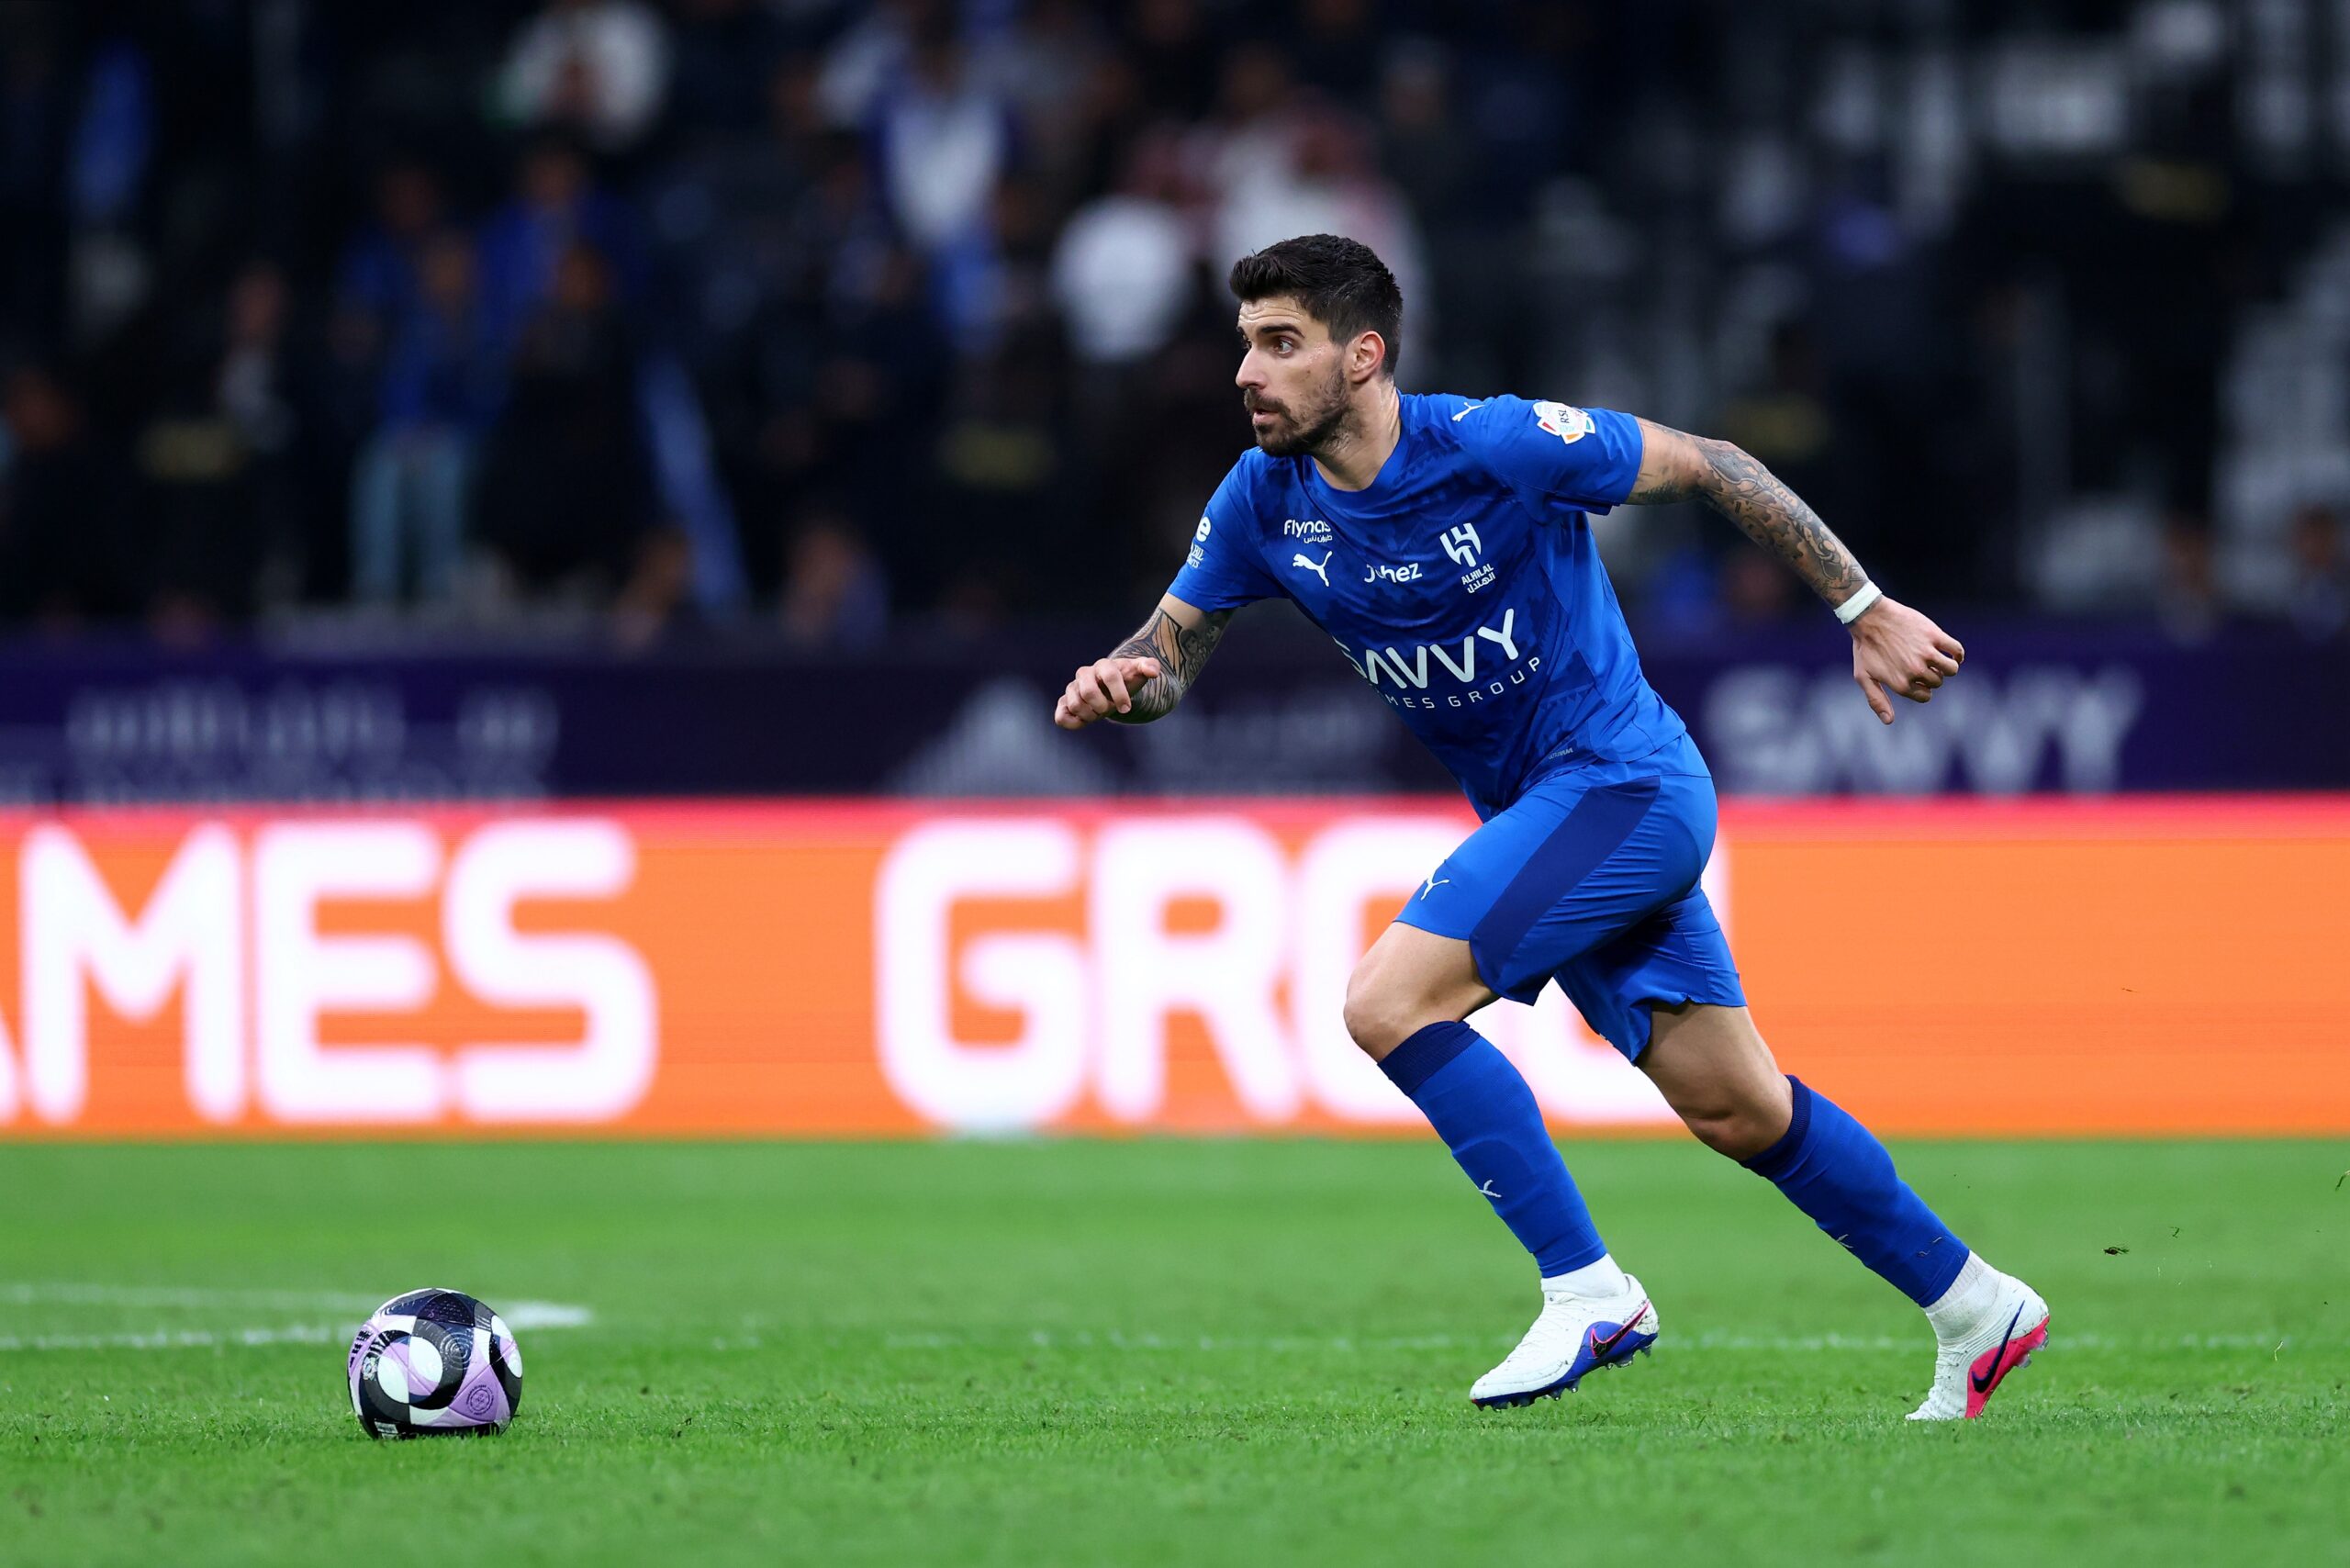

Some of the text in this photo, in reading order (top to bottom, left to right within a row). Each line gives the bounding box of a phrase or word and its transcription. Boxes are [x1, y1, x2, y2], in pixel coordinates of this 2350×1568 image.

[1461, 563, 1494, 585] ALHILAL
[1377, 657, 1540, 709] MES GROUP
[0, 818, 659, 1125] MES
